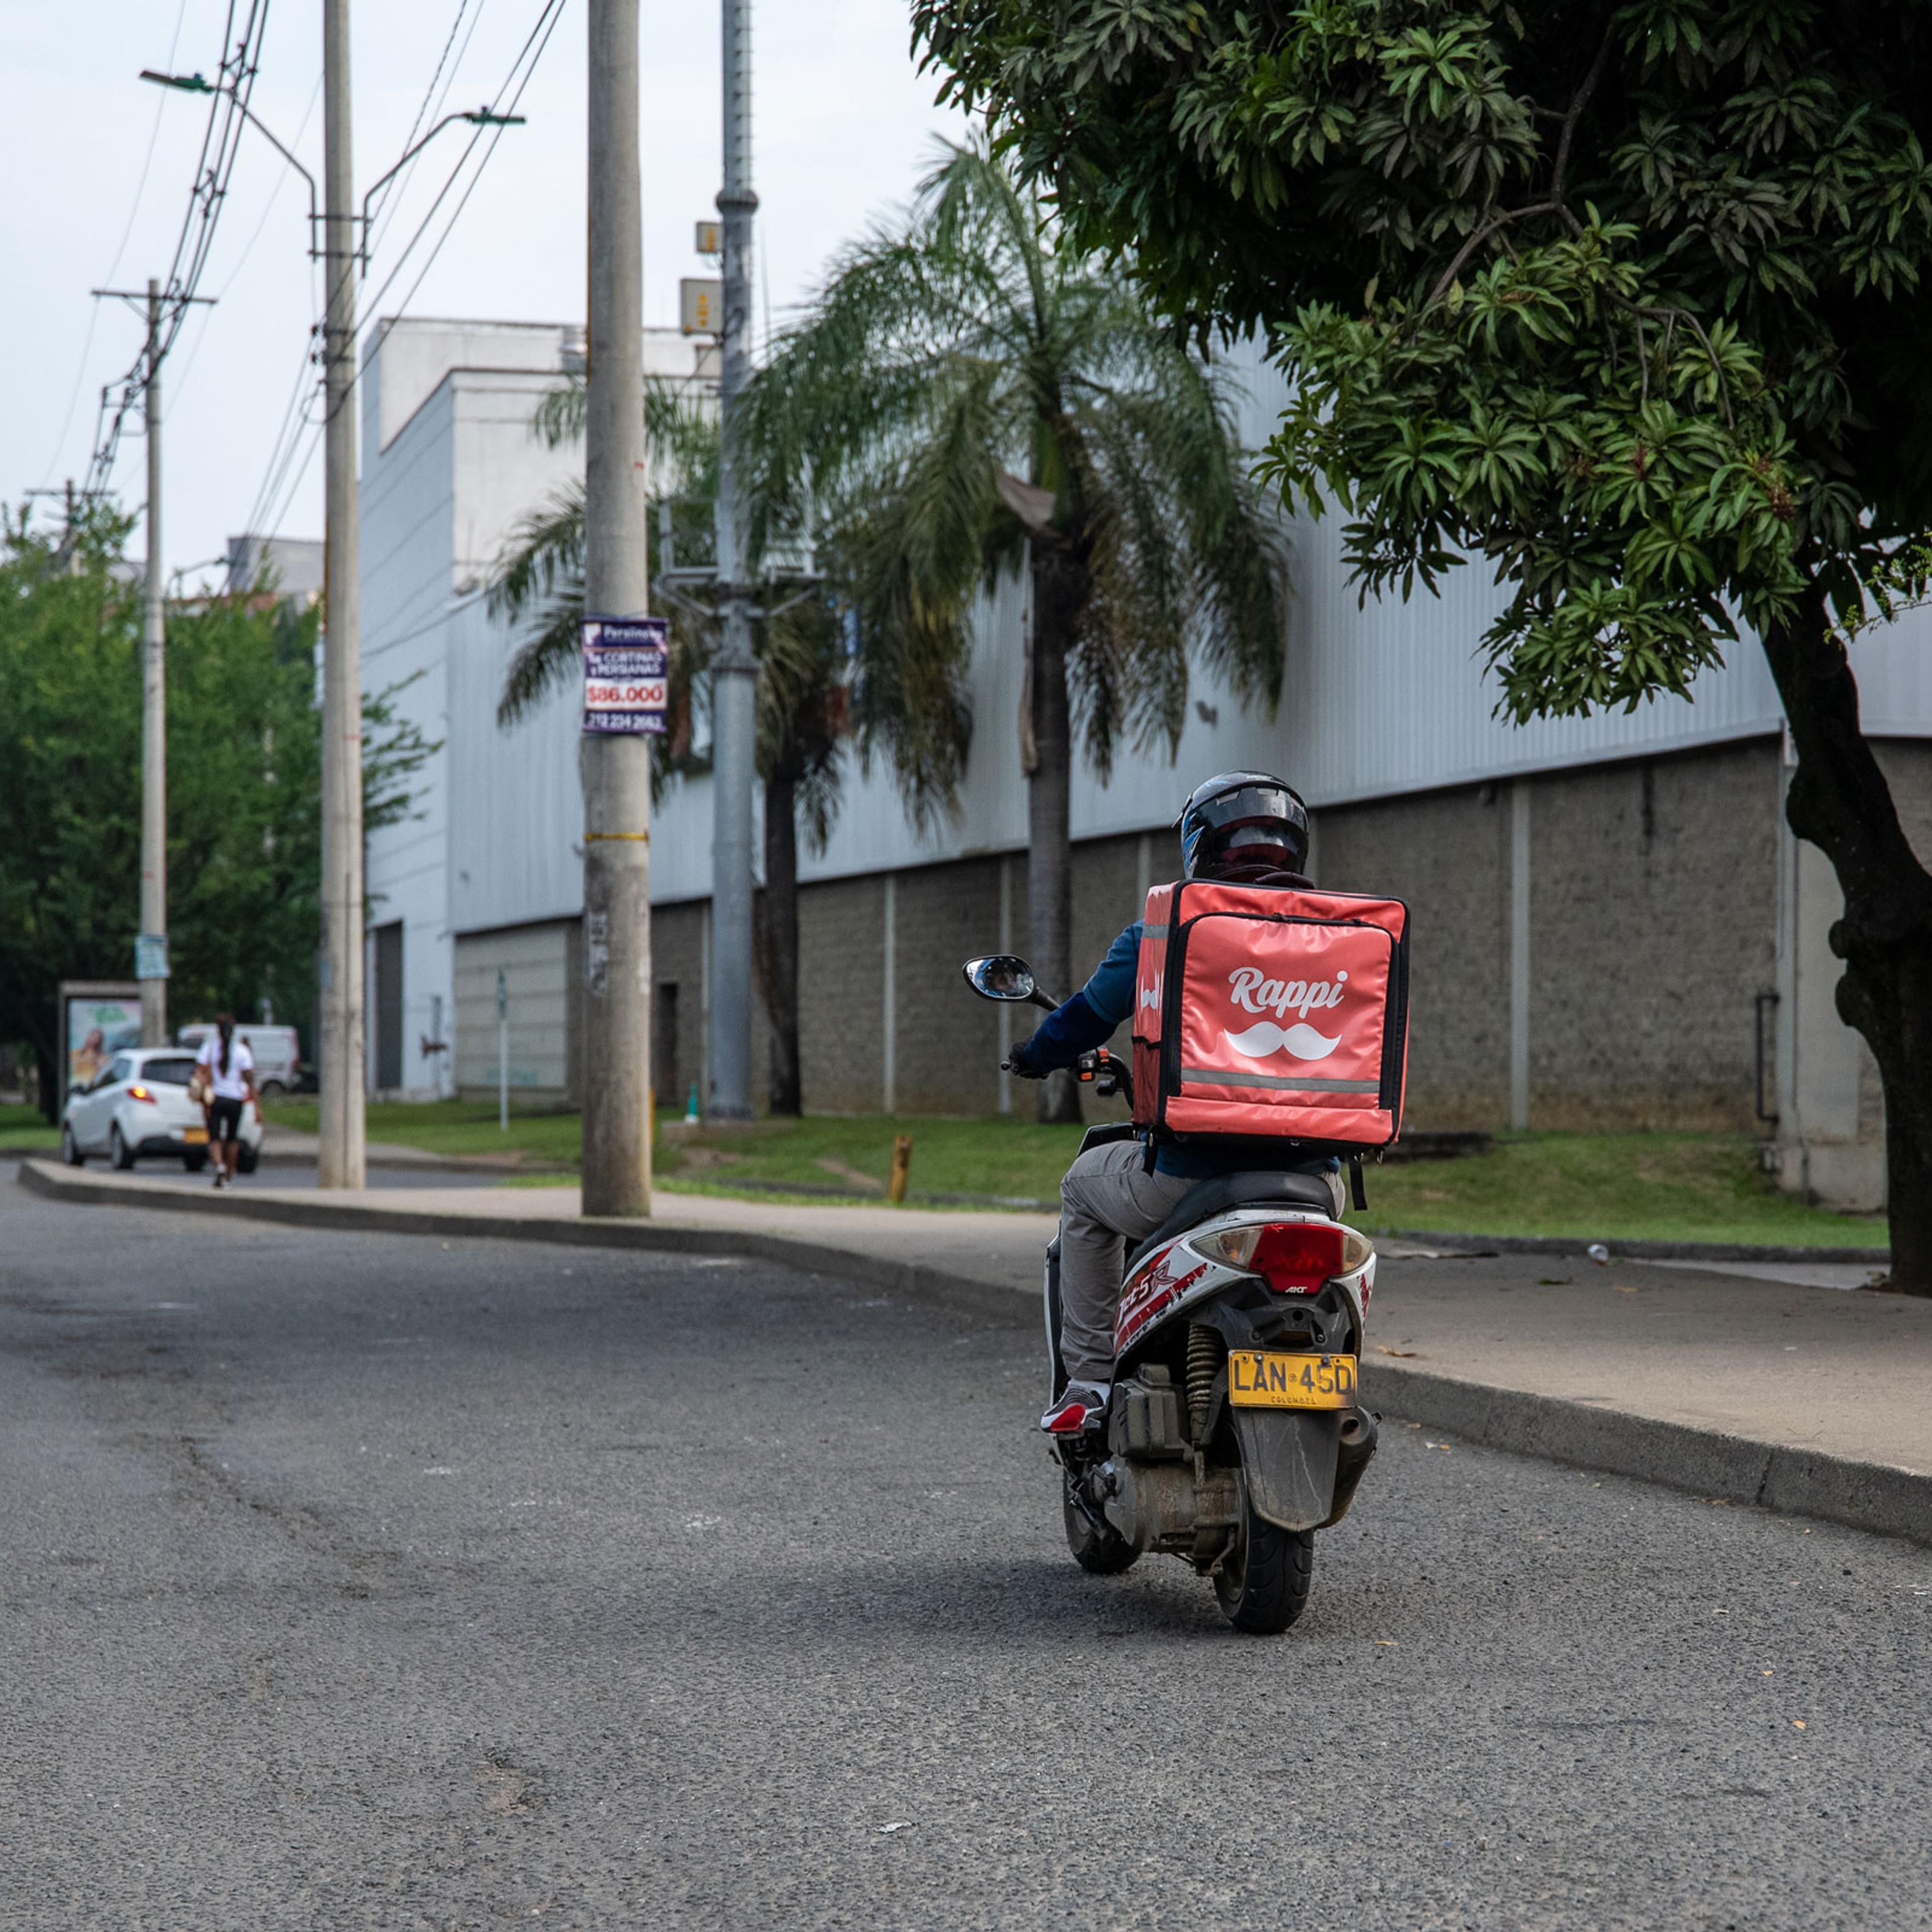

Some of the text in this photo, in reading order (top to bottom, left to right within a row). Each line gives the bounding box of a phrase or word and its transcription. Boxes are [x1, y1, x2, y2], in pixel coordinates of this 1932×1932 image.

[1228, 967, 1348, 1019] Rappi
[1234, 1360, 1286, 1392] LAN
[1271, 1396, 1317, 1405] COLOMBIA
